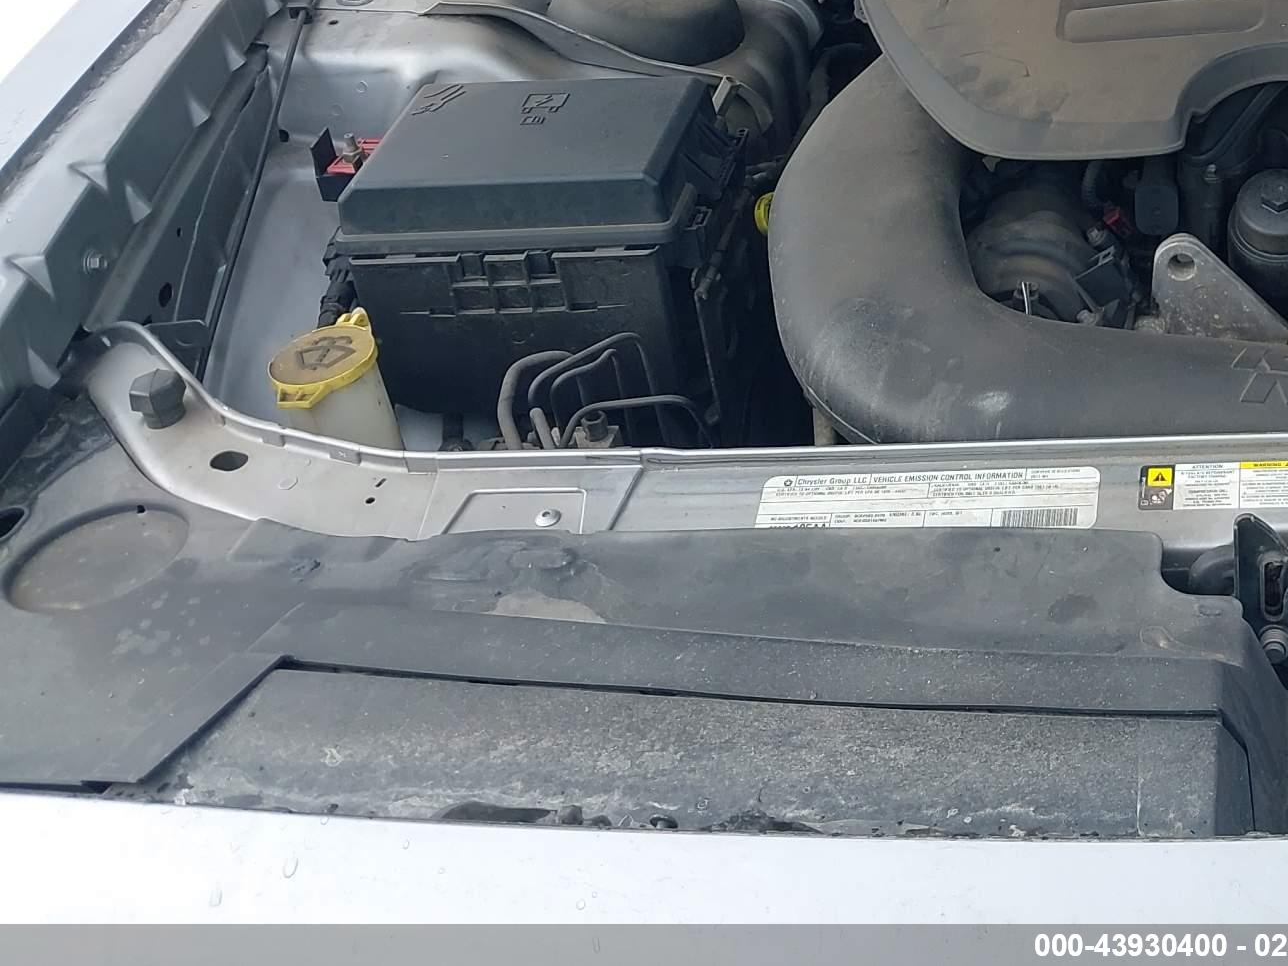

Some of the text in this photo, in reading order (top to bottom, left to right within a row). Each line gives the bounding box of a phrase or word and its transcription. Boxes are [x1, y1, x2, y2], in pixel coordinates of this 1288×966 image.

[798, 476, 867, 486] Chrysler Group LLC
[873, 475, 901, 483] VEHICLE
[904, 474, 938, 482] EMISSION
[940, 473, 972, 481] CONTROL
[974, 471, 1024, 480] INFORMATION
